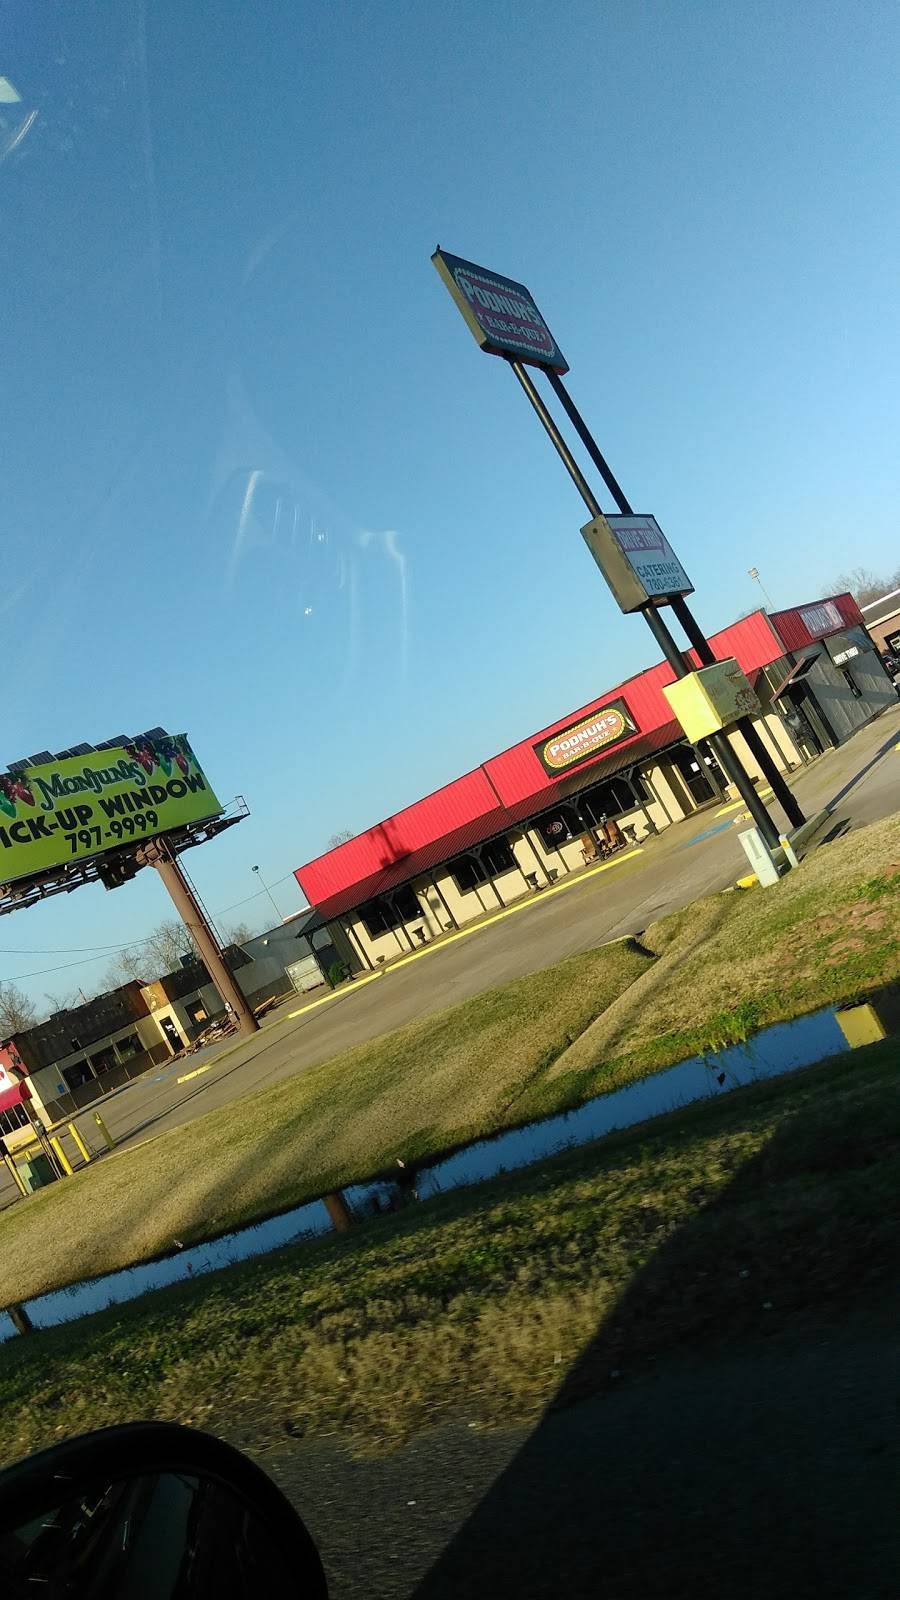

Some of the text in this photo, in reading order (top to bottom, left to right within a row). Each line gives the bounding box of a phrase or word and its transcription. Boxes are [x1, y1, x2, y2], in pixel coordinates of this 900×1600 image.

[636, 562, 680, 578] CATERING
[548, 714, 617, 757] PODNUH'S
[0, 773, 206, 849] ICK-UP WINDOW
[64, 810, 159, 854] 797-9999
